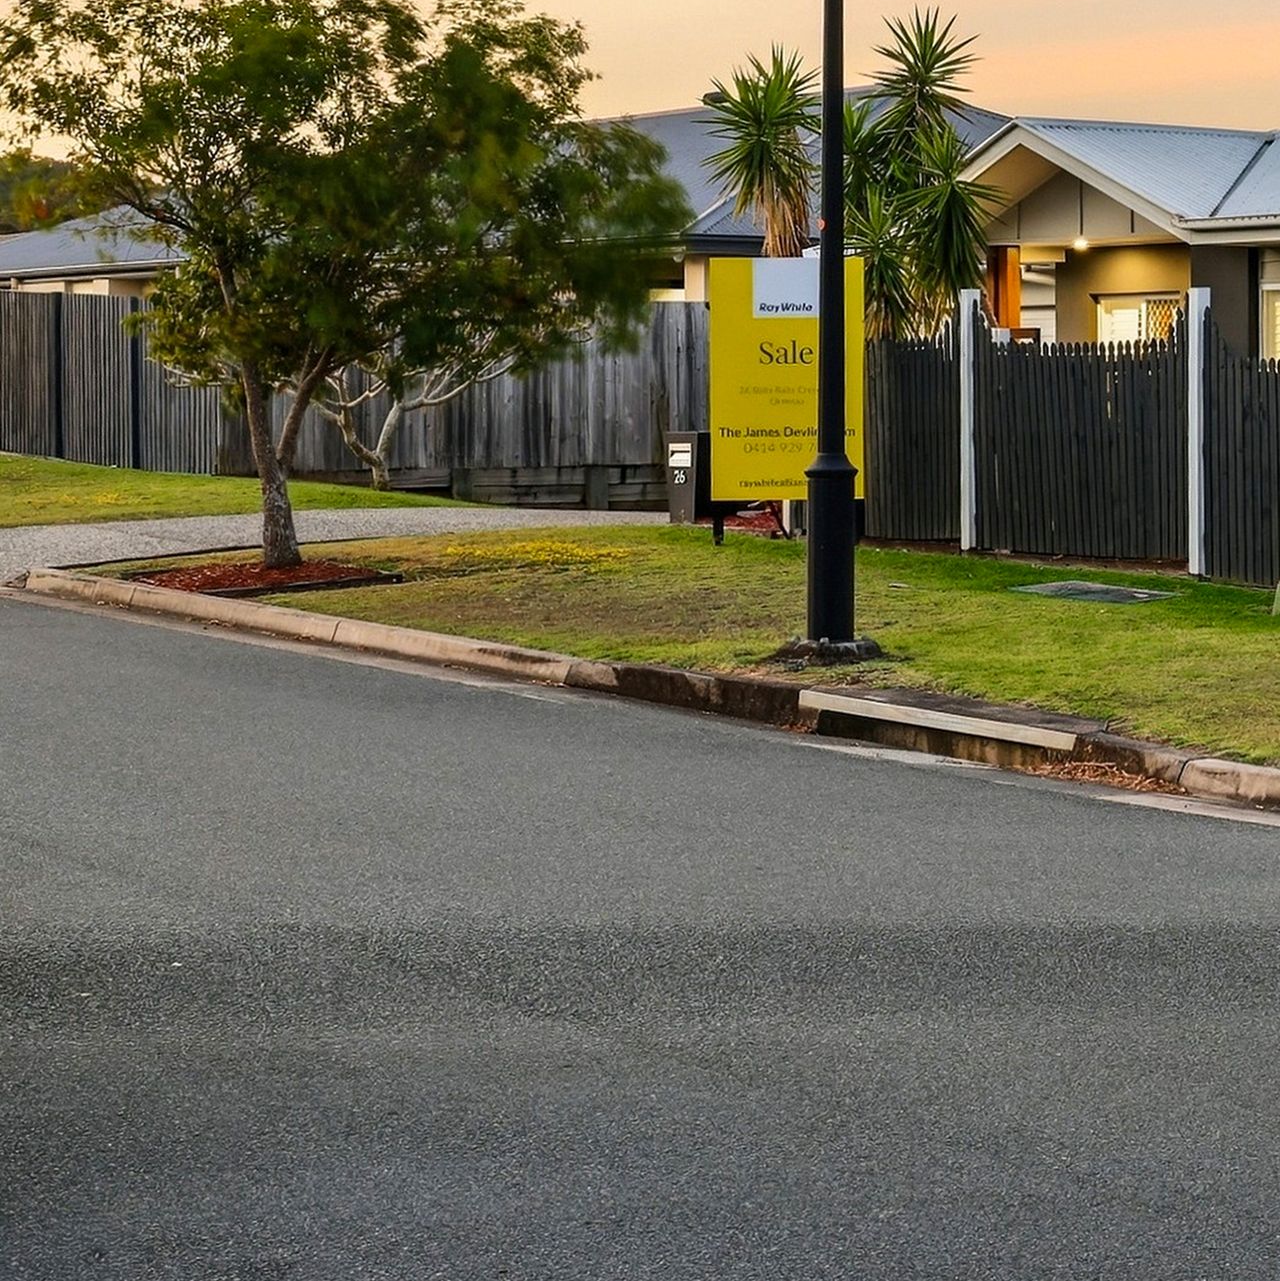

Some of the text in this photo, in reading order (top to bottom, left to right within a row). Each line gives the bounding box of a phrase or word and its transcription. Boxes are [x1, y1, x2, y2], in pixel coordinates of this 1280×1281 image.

[759, 339, 814, 365] Sale
[719, 426, 742, 438] The
[743, 426, 780, 439] James
[674, 469, 686, 484] 26
